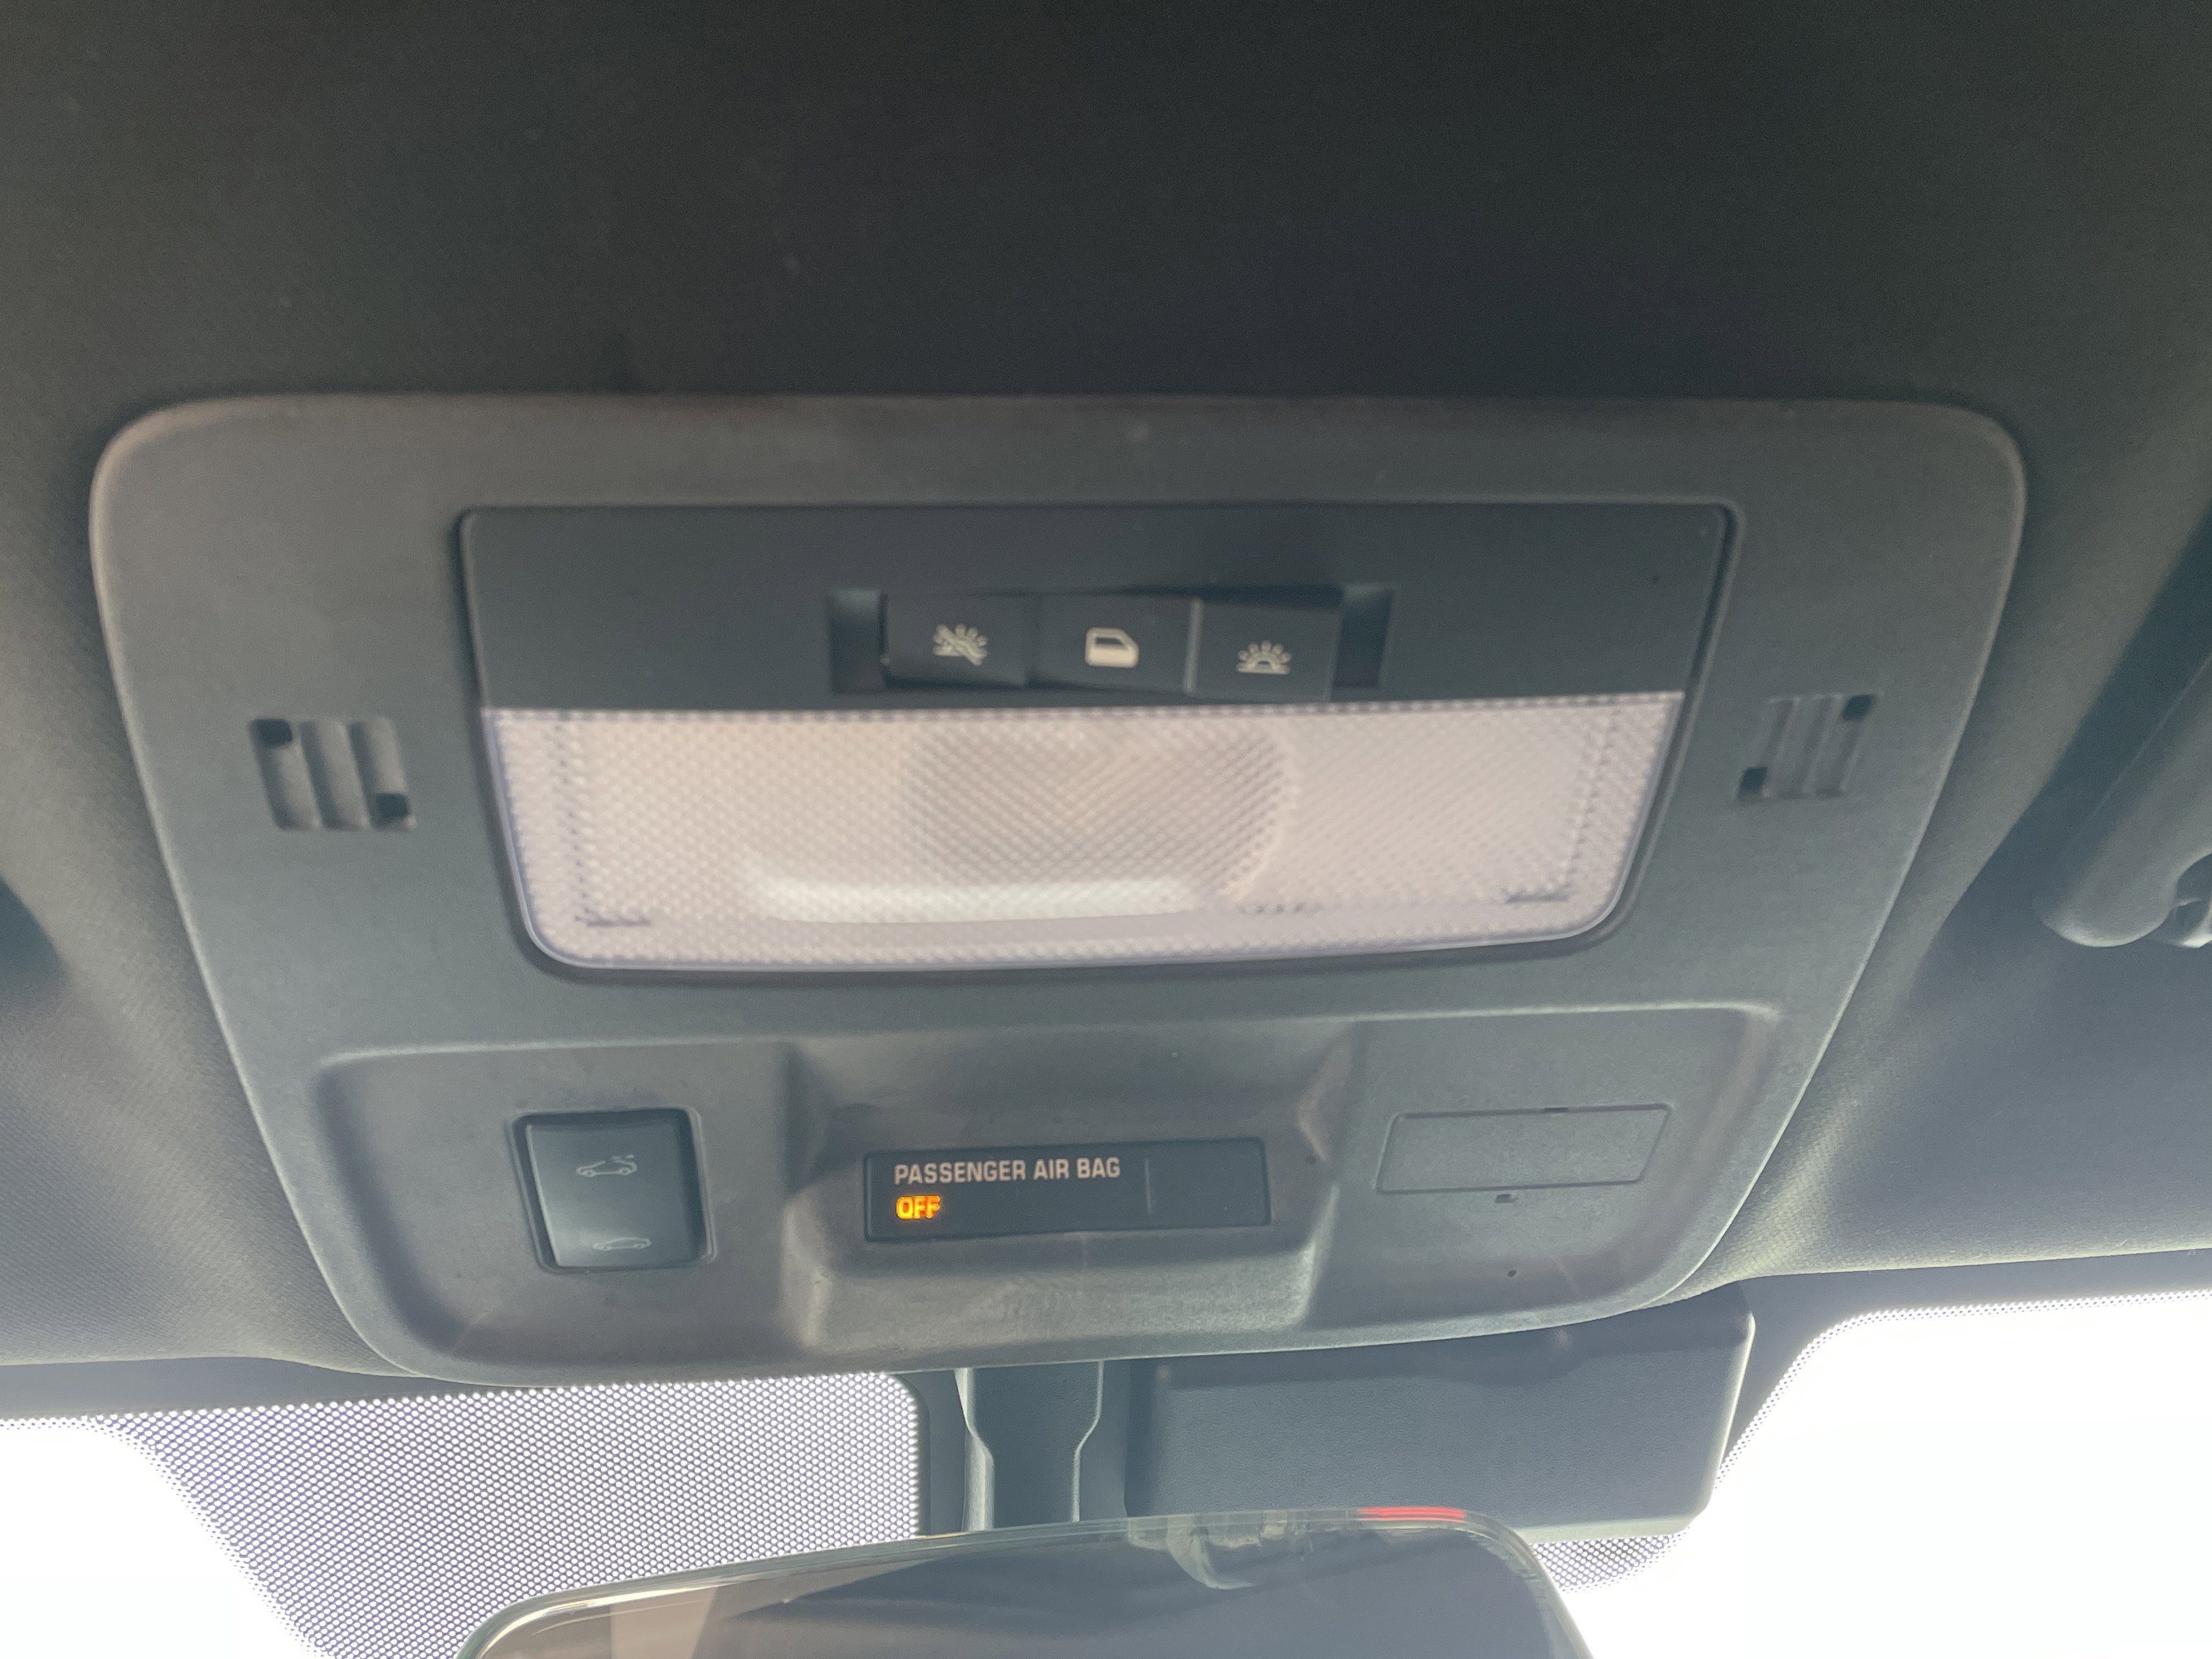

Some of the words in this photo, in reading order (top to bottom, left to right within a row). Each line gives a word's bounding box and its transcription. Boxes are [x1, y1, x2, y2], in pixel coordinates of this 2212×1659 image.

[894, 1159, 1026, 1185] PASSENGER
[1032, 1158, 1070, 1180] AIR
[1076, 1156, 1121, 1179] BAG
[895, 1195, 941, 1220] OFF
